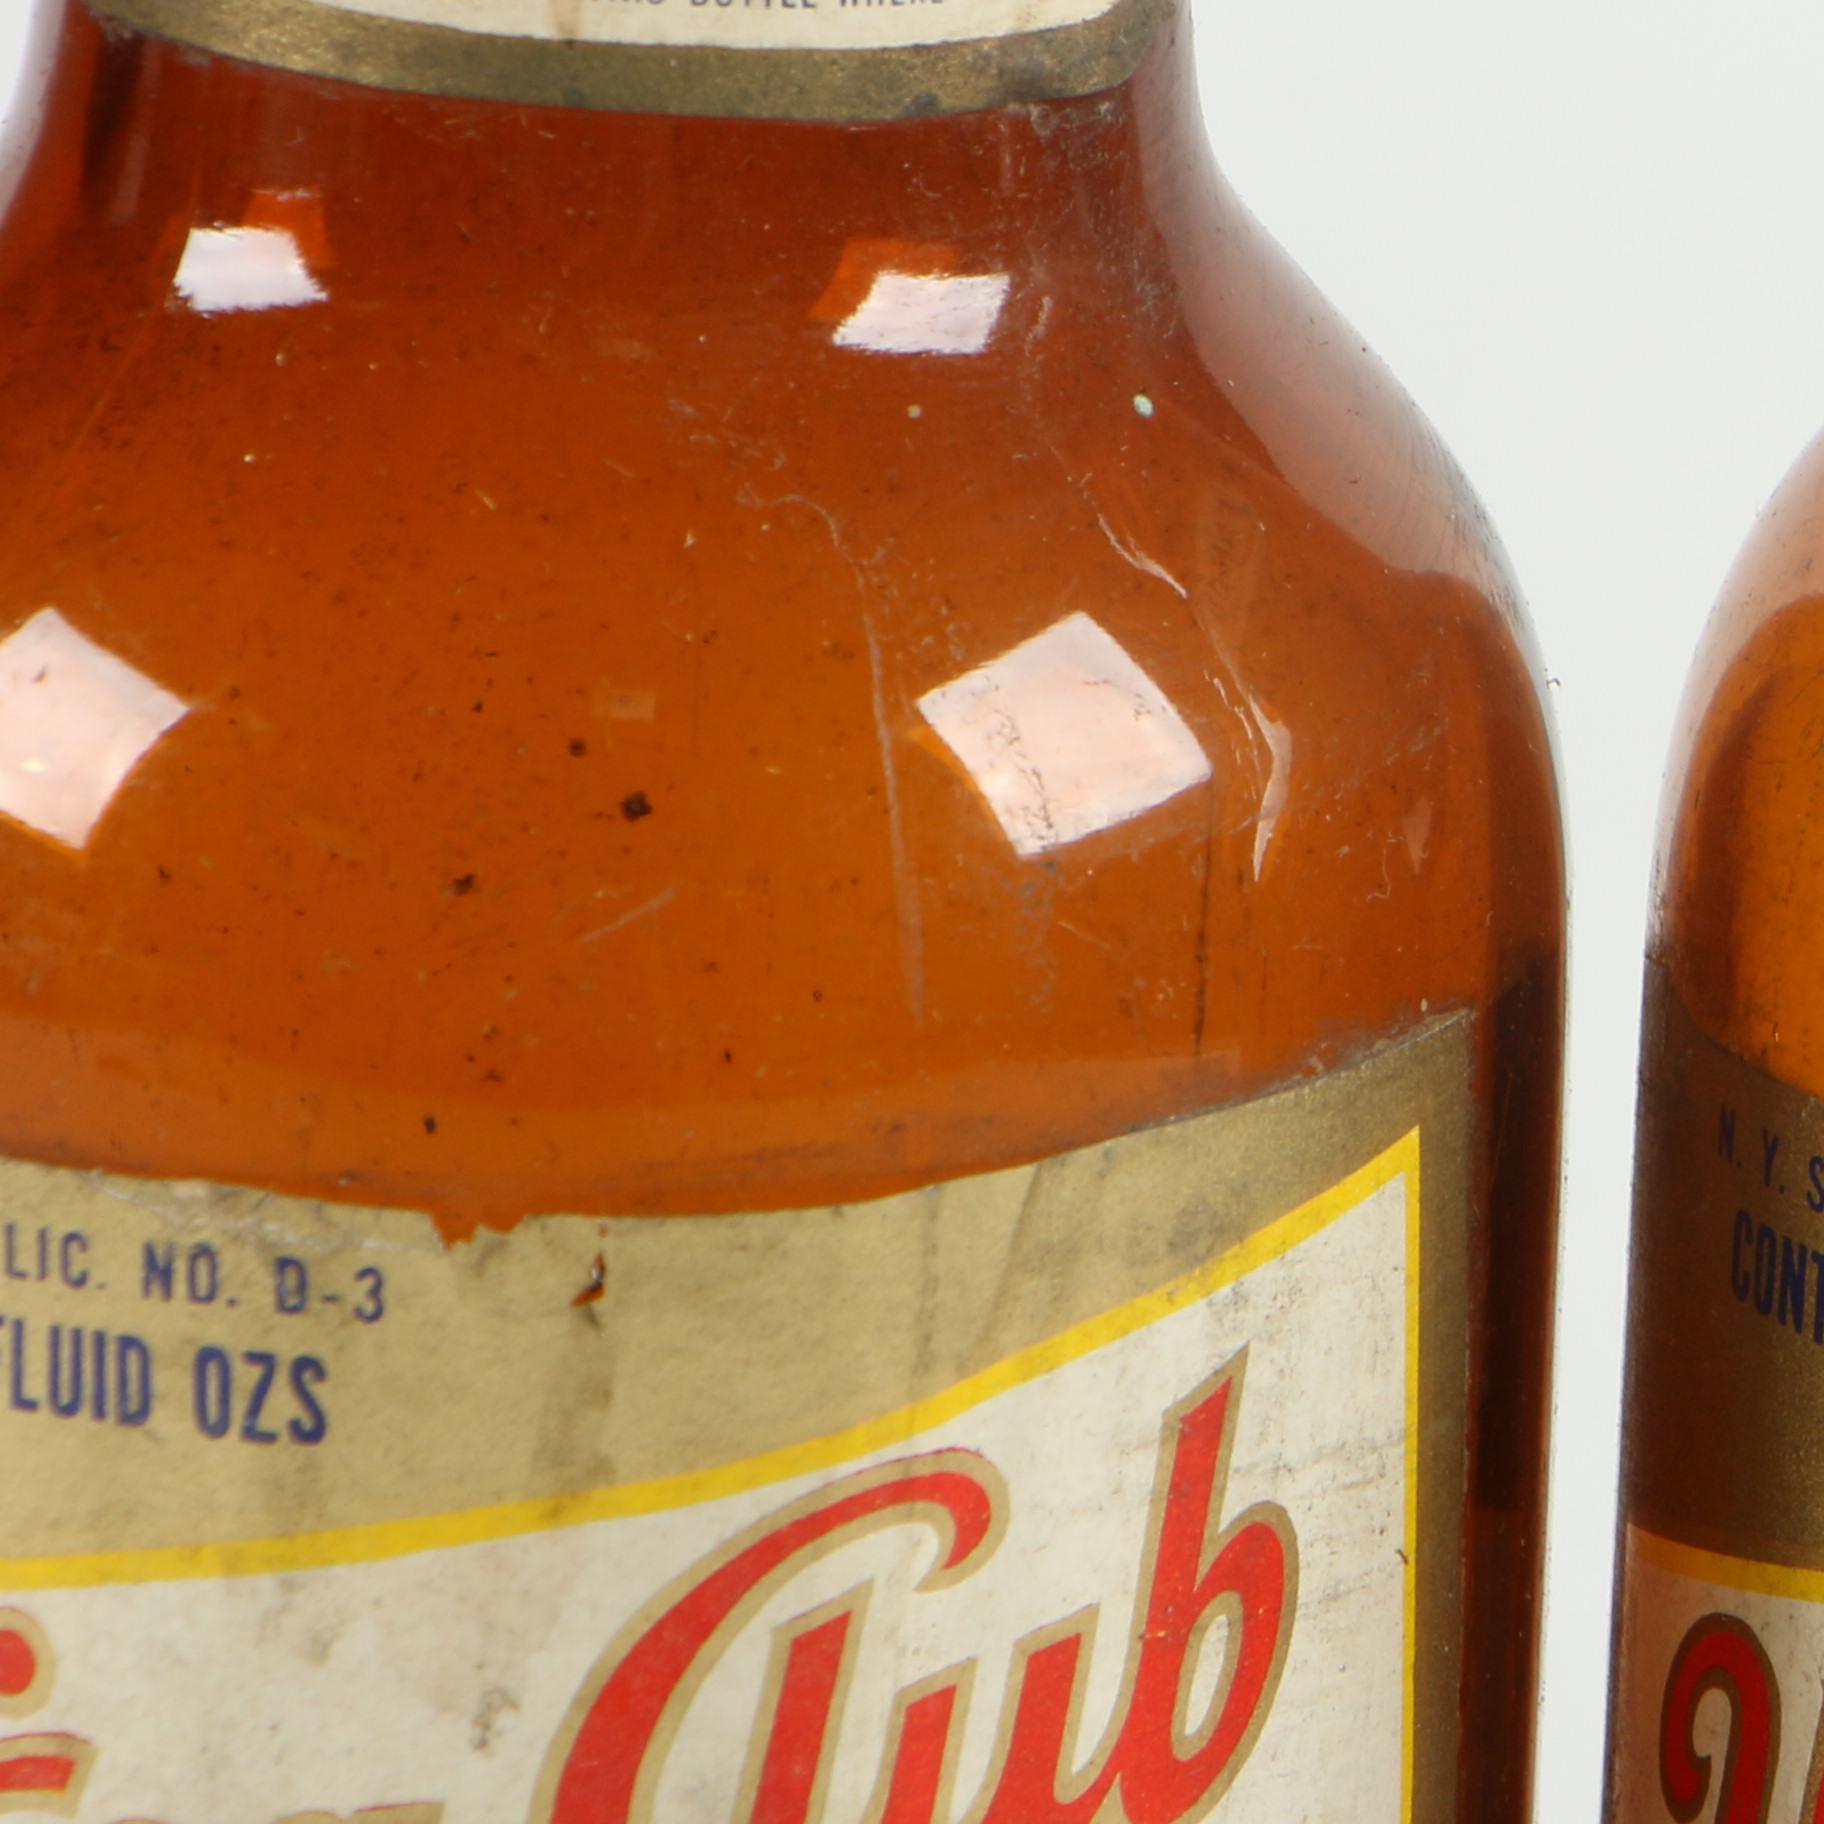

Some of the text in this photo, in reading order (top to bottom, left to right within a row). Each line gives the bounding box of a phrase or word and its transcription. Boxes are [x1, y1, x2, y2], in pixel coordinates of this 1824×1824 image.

[3, 1222, 386, 1324] LIC. NO. D-3
[0, 1314, 328, 1446] LUID OZS
